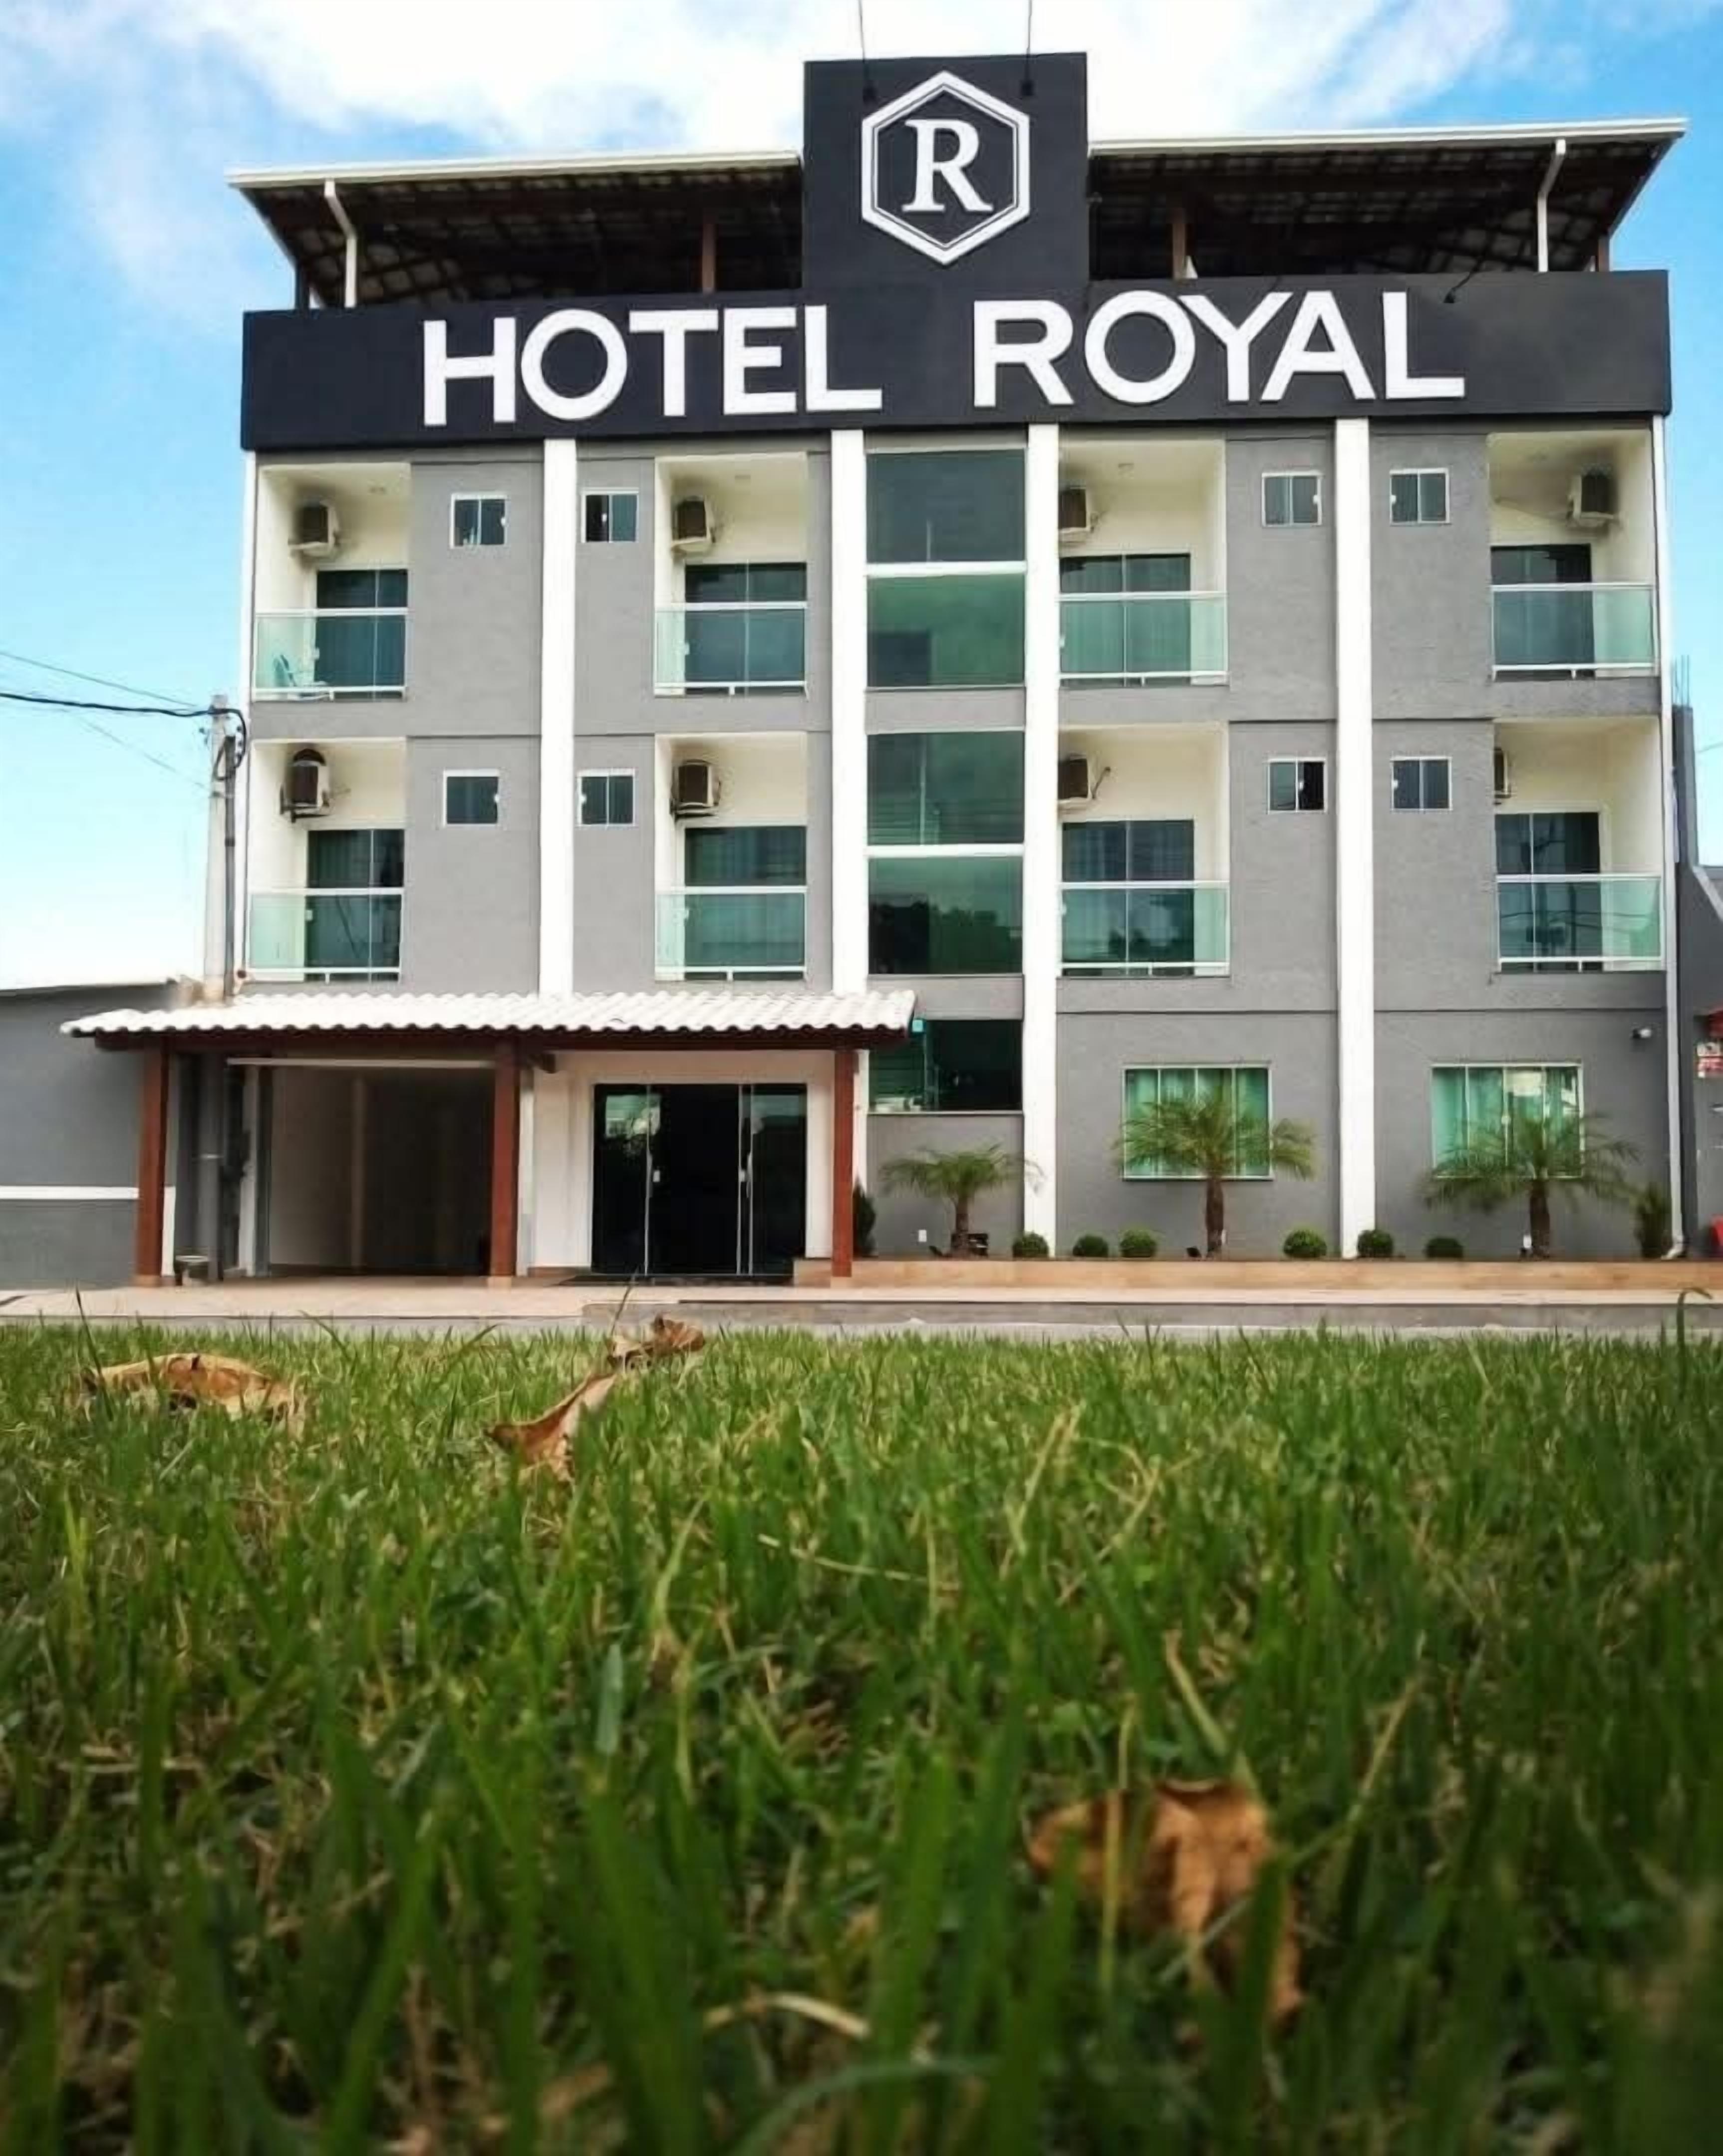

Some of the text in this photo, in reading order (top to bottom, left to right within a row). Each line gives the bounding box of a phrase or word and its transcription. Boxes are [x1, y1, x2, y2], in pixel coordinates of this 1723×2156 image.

[902, 119, 993, 213] R
[423, 289, 1466, 426] HOTEL ROYAL
